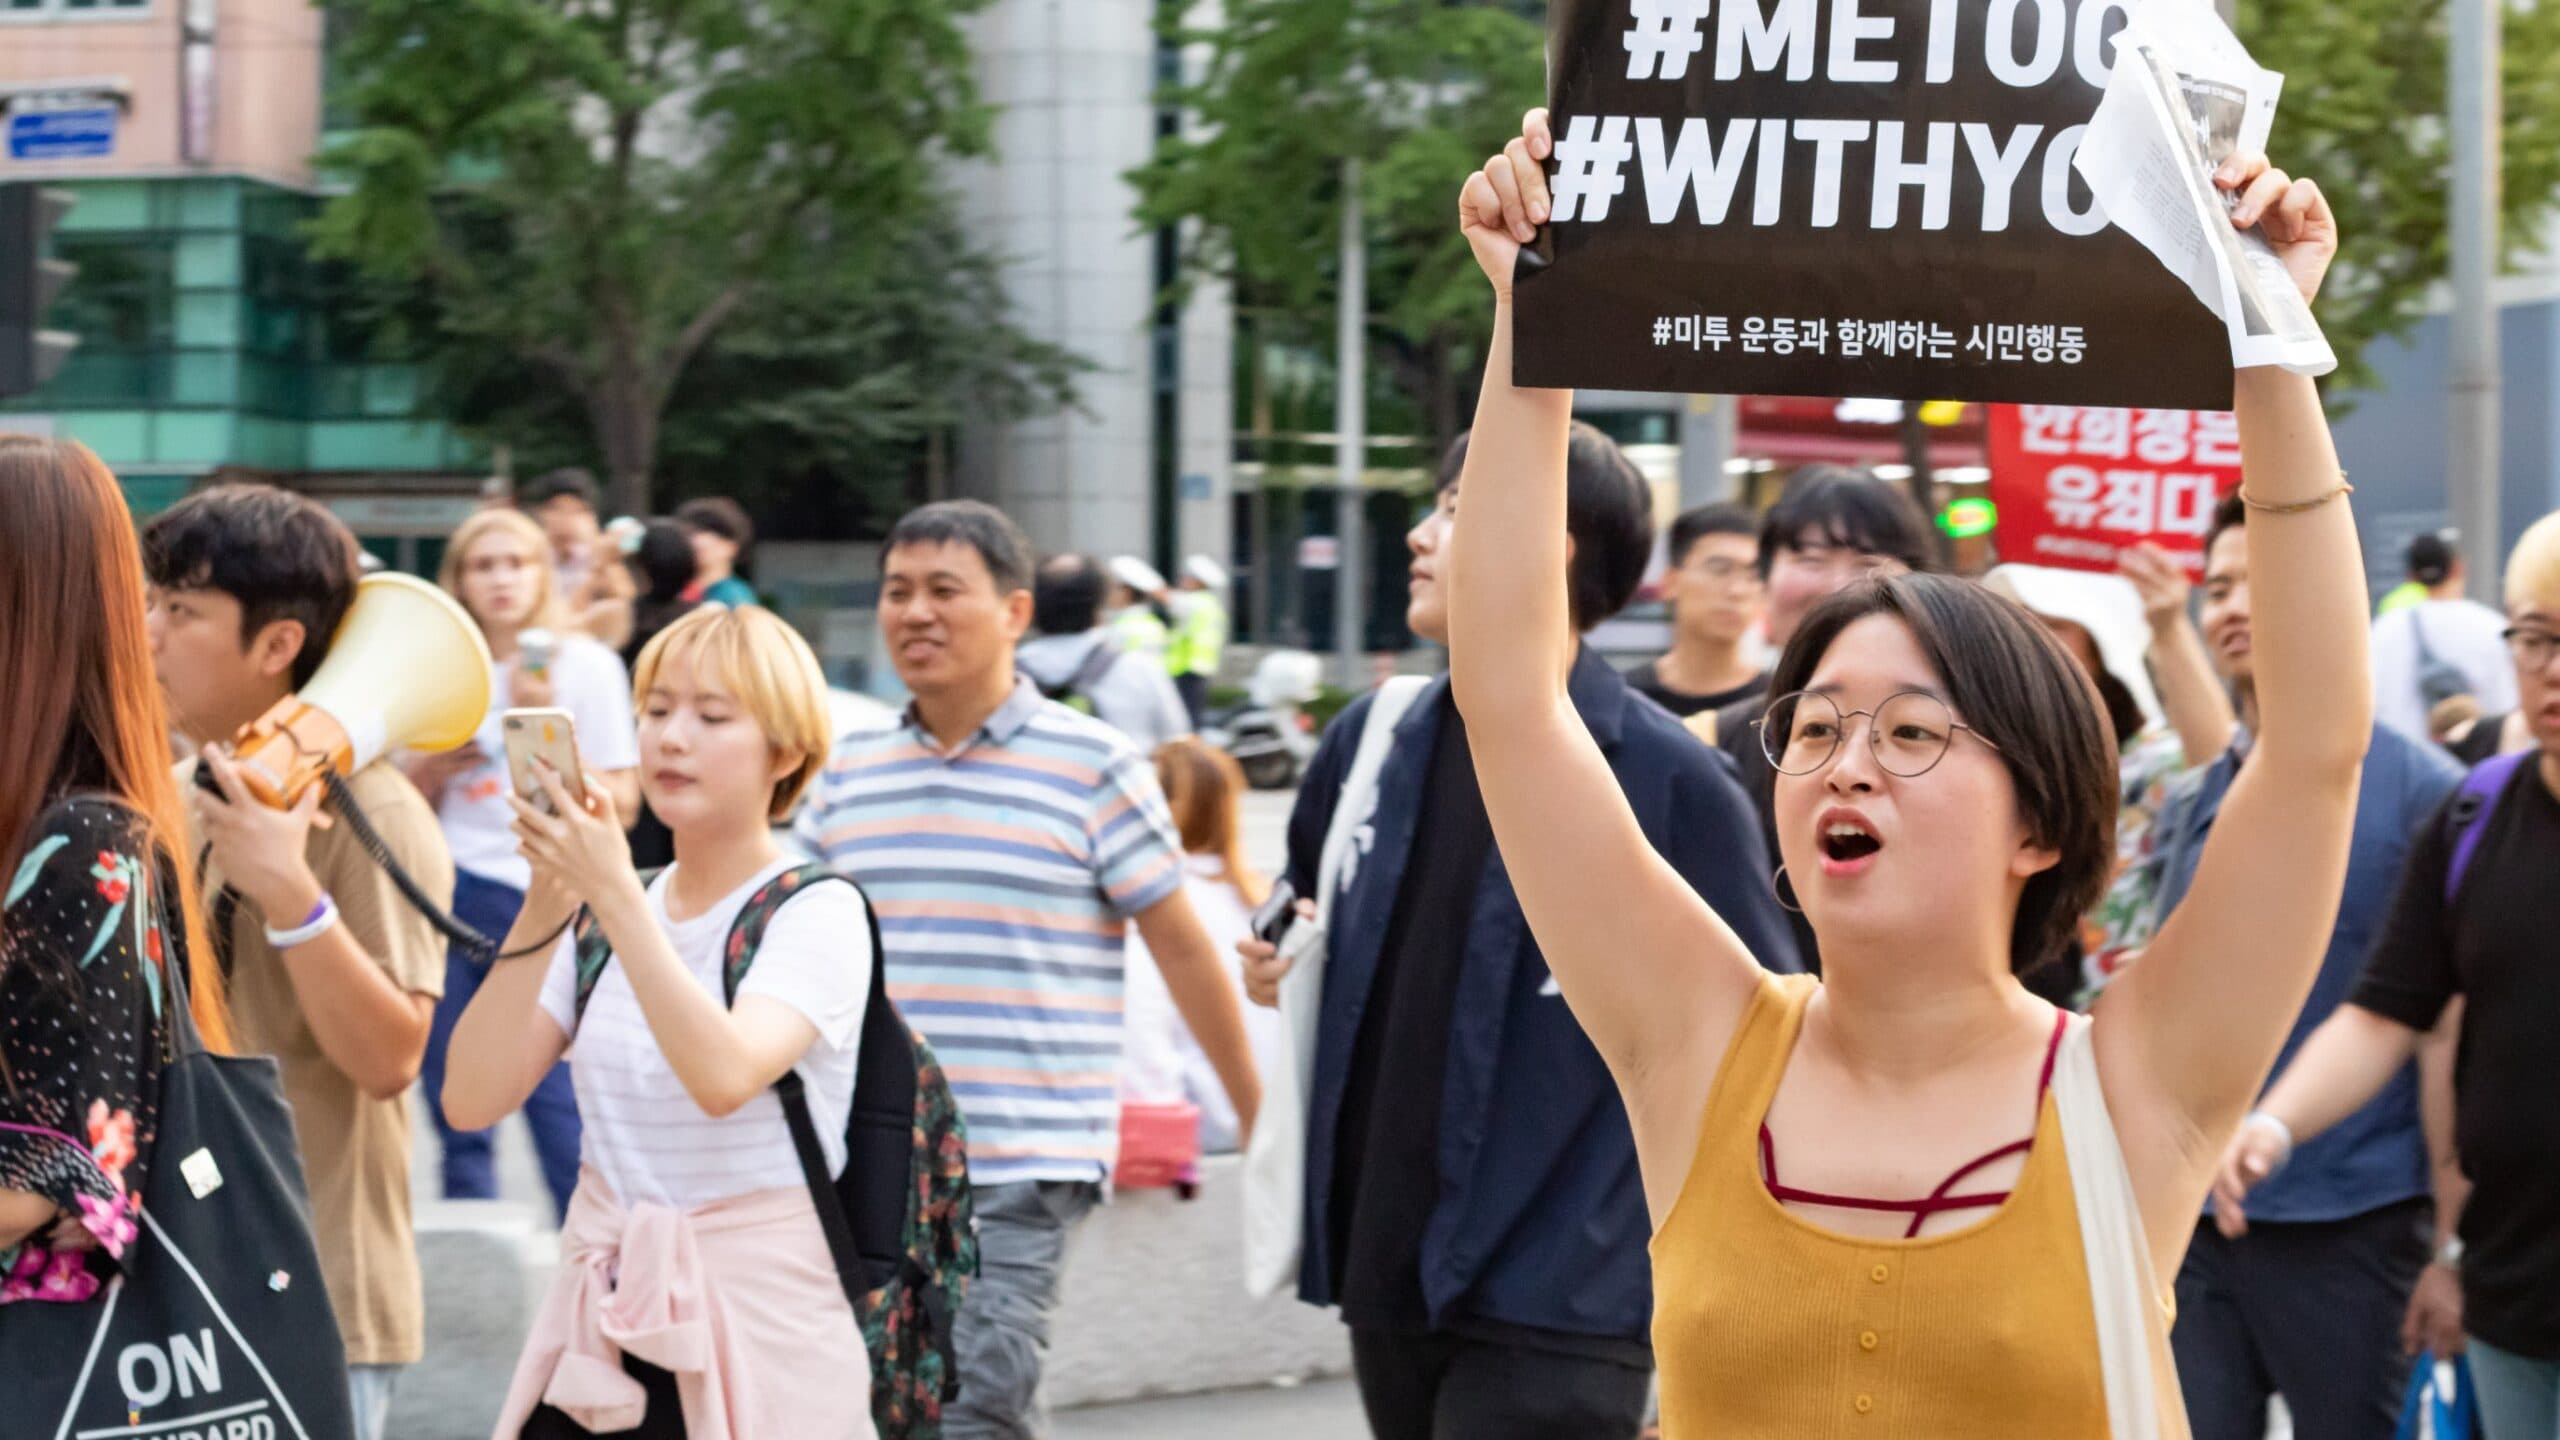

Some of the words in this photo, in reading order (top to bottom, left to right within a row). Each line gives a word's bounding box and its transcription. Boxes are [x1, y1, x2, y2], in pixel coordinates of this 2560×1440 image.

[1548, 115, 2112, 237] #WITHYO
[1652, 314, 1732, 352] #미투
[1739, 316, 1830, 355] 운동과
[1837, 318, 1957, 359] 함께하는
[1965, 323, 2087, 364] 시민행동
[117, 1327, 222, 1408] ON
